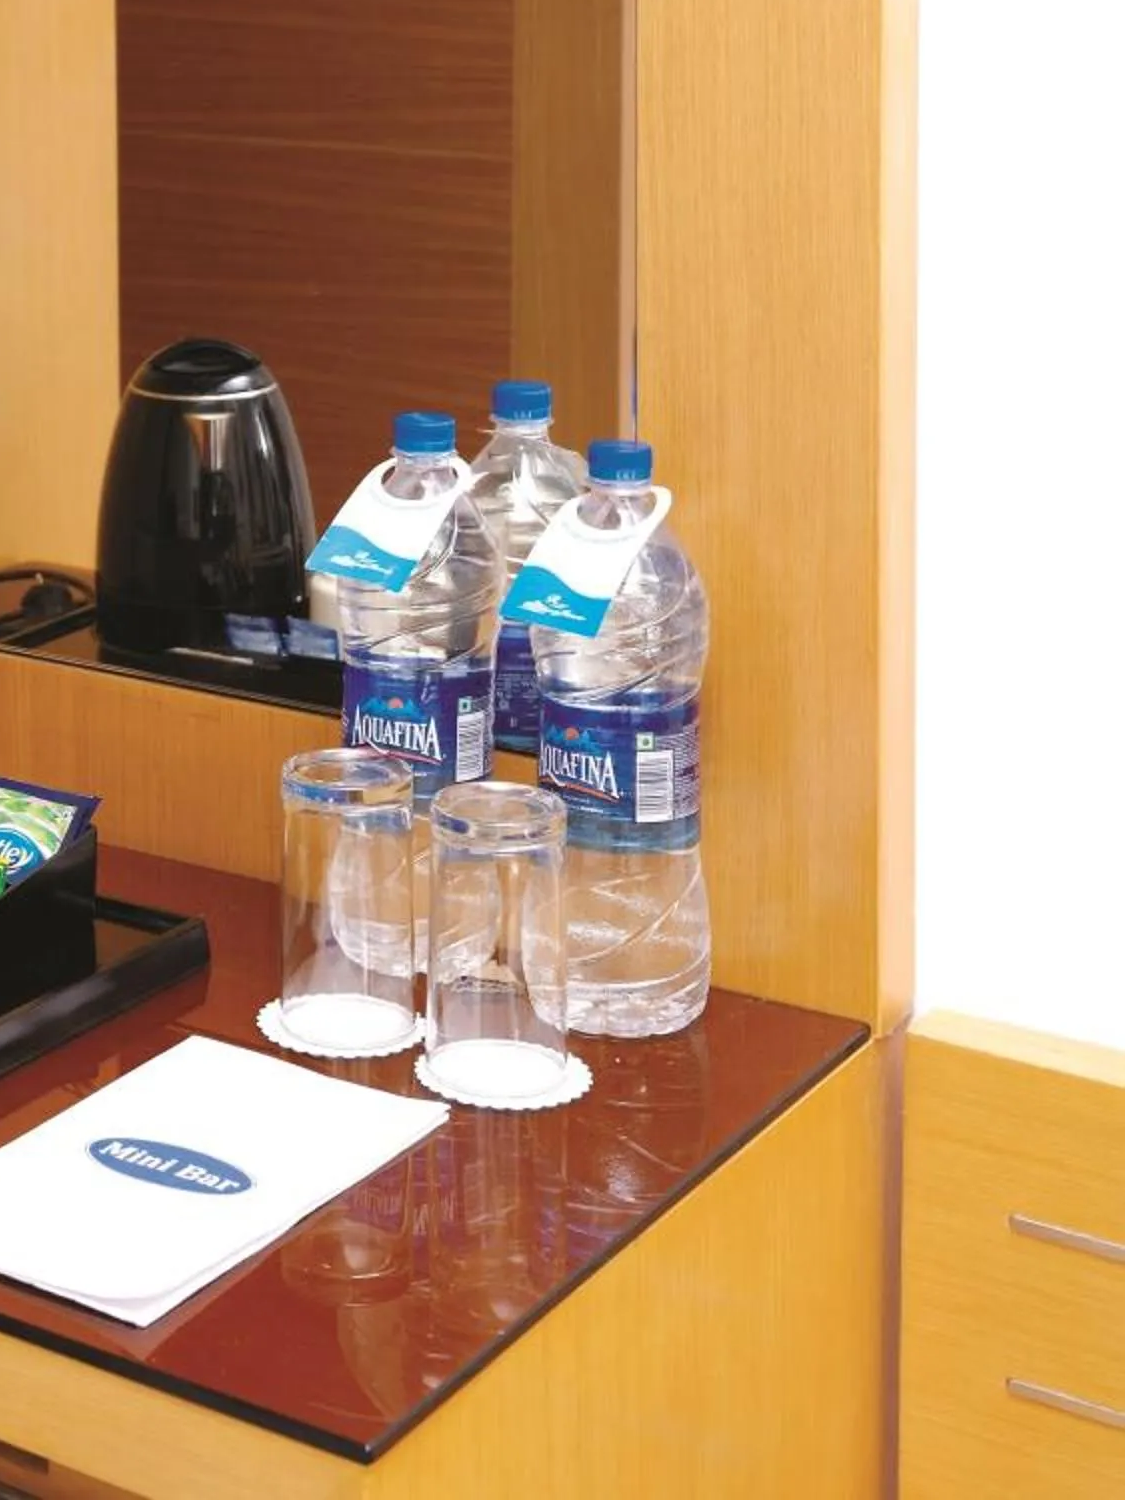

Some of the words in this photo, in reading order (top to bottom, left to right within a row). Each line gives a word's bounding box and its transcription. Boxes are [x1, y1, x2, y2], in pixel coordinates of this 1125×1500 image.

[350, 703, 443, 762] AQUAFINA
[98, 1140, 179, 1173] Mini
[173, 1163, 241, 1192] Bar
